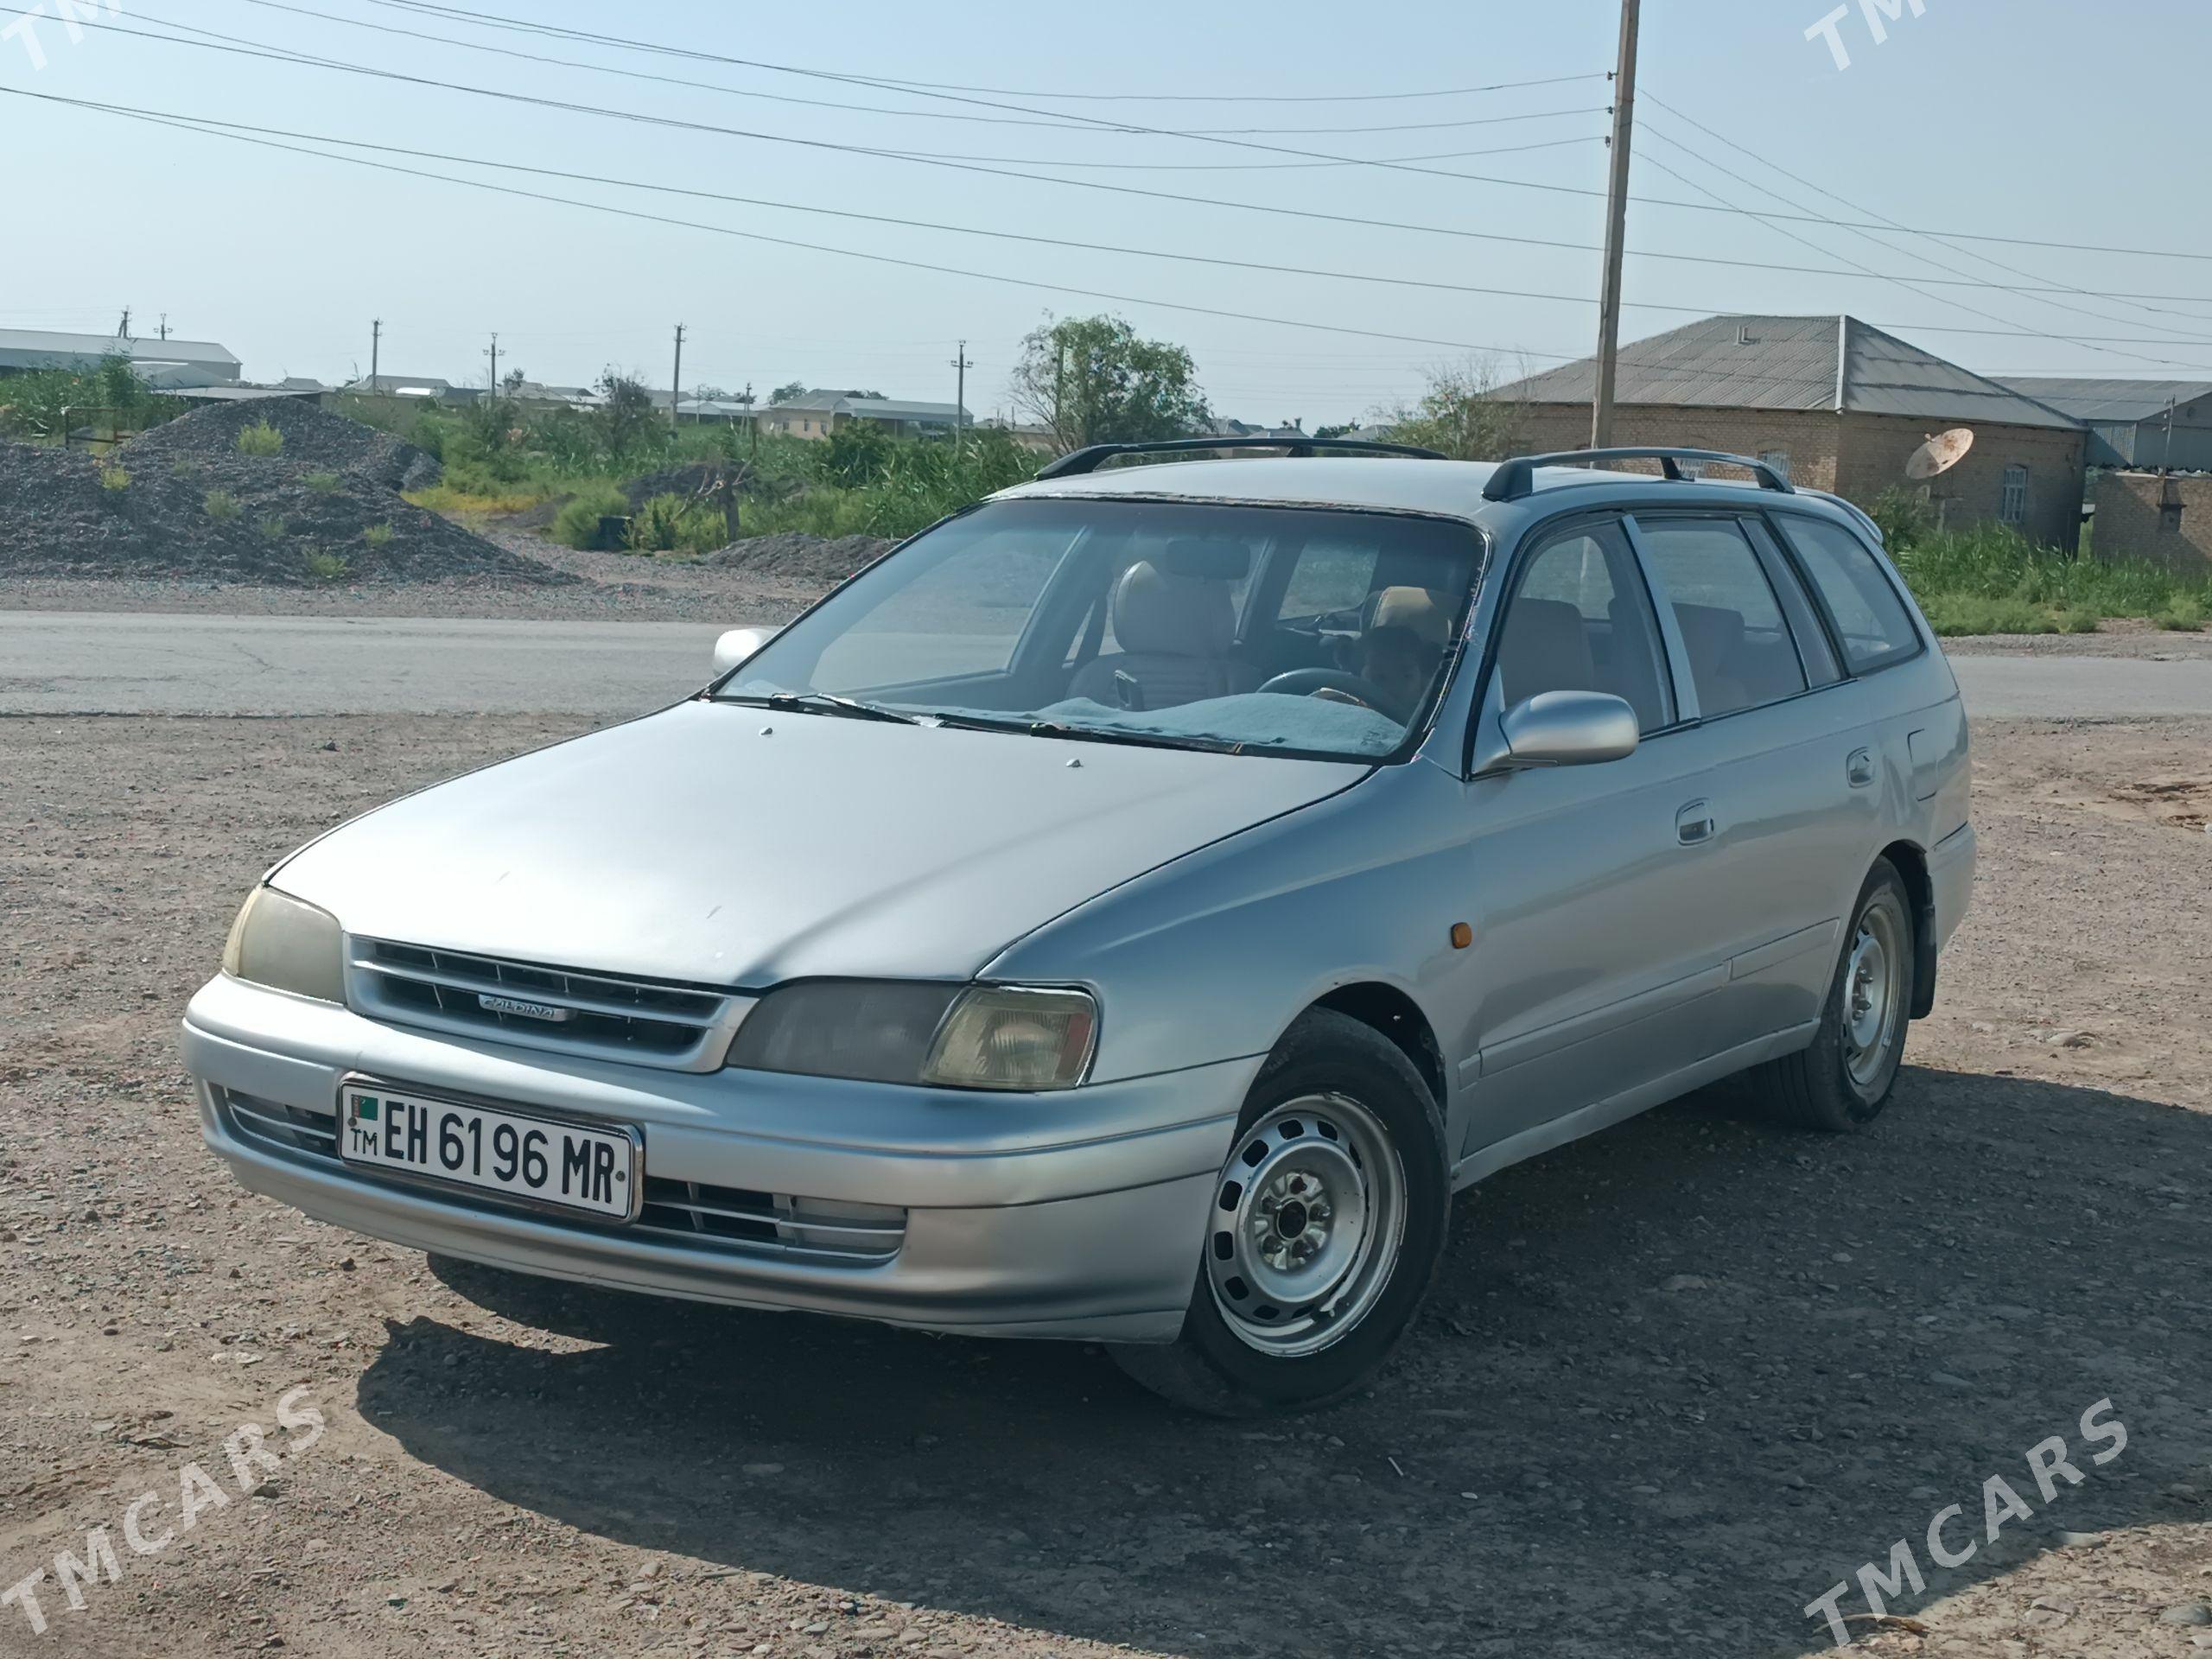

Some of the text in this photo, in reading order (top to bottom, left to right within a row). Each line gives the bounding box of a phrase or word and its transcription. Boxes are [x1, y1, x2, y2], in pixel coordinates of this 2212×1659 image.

[350, 1127, 378, 1156] TM
[385, 1100, 615, 1204] EH 6196 MR
